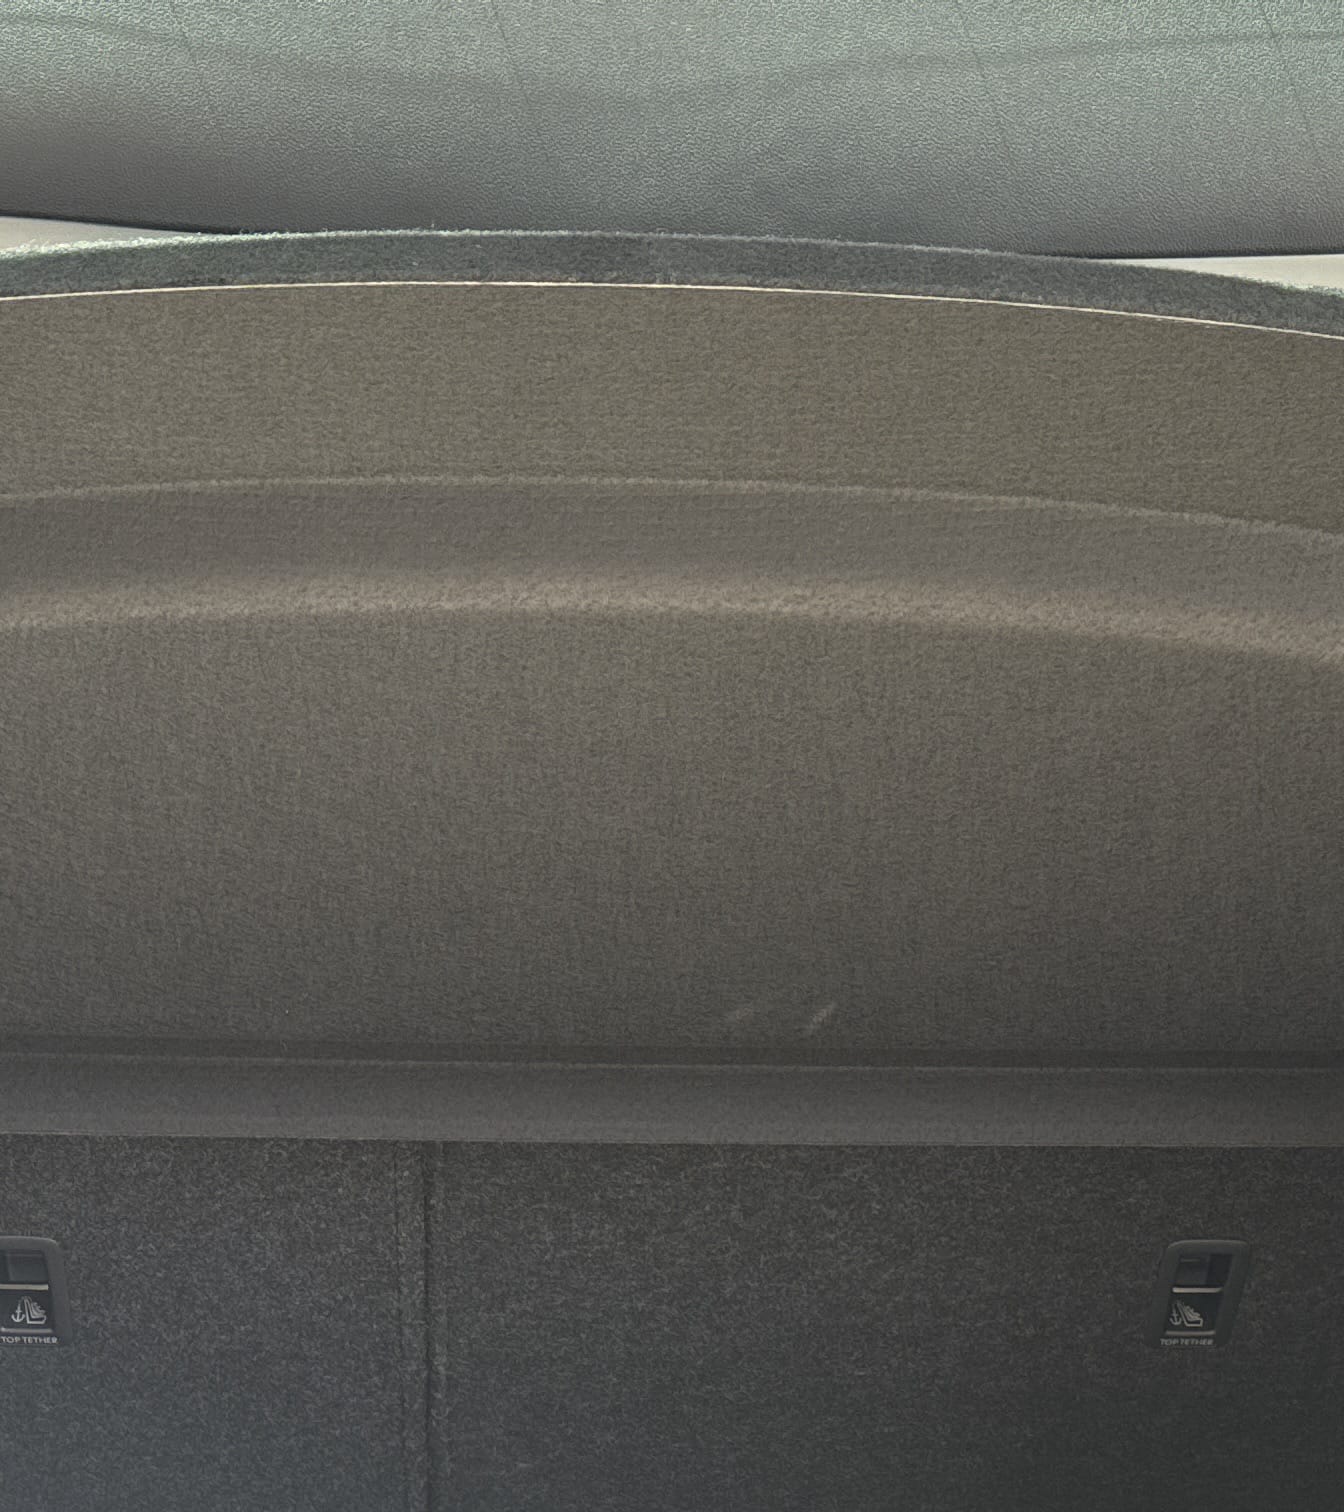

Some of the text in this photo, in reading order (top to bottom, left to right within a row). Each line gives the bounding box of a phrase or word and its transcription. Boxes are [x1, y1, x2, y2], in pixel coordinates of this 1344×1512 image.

[0, 1336, 58, 1344] TOP TETHER
[1159, 1338, 1214, 1346] TOP TETHER
